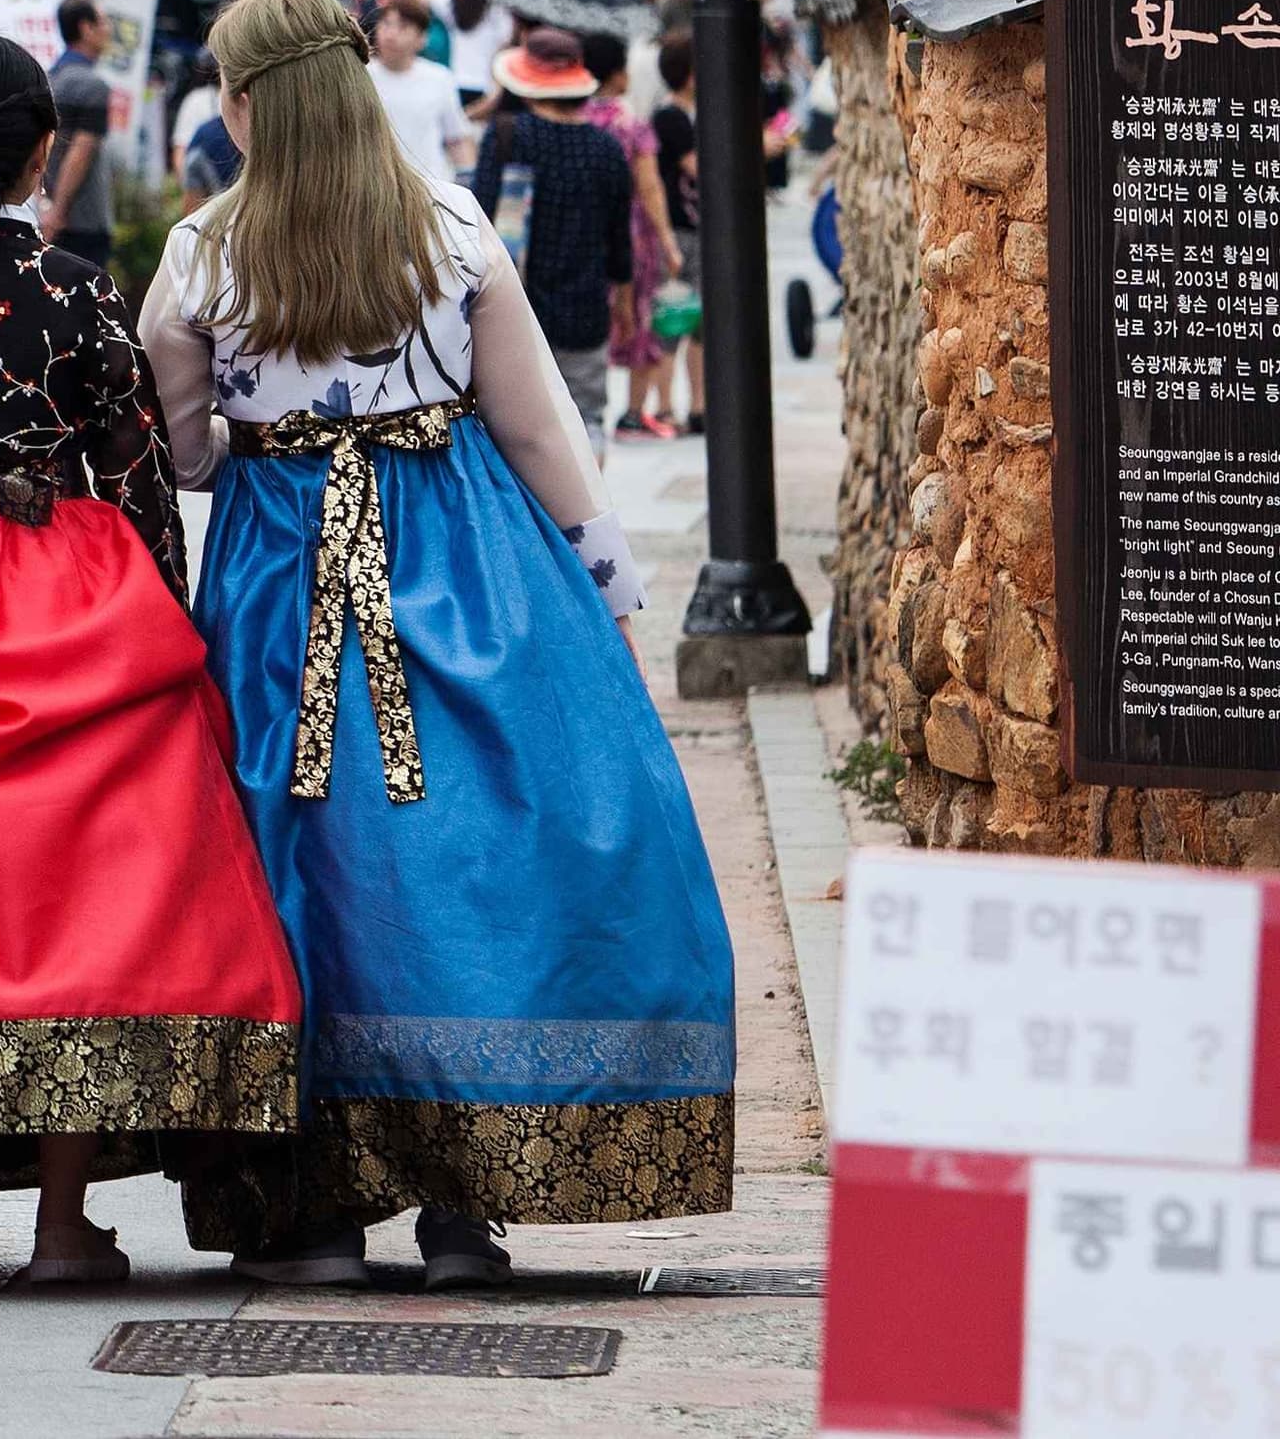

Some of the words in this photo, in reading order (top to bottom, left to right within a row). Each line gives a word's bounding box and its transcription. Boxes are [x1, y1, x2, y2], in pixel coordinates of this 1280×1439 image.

[1229, 97, 1245, 117] 는
[1110, 119, 1157, 140] 황제와
[1164, 121, 1240, 142] 명성황후의
[1249, 123, 1280, 143] 직계
[1231, 159, 1246, 178] 는
[1112, 181, 1190, 202] 이어간다는
[1198, 183, 1229, 203] 이을
[1113, 206, 1174, 227] 의미에서
[1183, 208, 1229, 228] 지어진
[1128, 243, 1175, 263] 전주는
[1183, 244, 1214, 264] 조선
[1222, 244, 1270, 266] 황실의
[1113, 268, 1166, 289] 으로써,
[1174, 270, 1229, 290] 2003년
[1237, 270, 1279, 291] 8월에
[1114, 292, 1129, 312] 에
[1138, 293, 1169, 314] 따라
[1176, 293, 1208, 314] 황손
[1217, 295, 1280, 316] 이석님을
[1114, 317, 1146, 337] 남로
[1153, 319, 1179, 339] 3가
[1186, 321, 1263, 341] 42-10번지
[1235, 357, 1252, 377] 는
[1116, 379, 1147, 399] 대한
[1155, 380, 1201, 401] 강연을
[1209, 381, 1257, 402] 하시는
[1118, 444, 1221, 464] Seounggwangjae
[1224, 448, 1234, 462] is
[1237, 451, 1245, 462] a
[1118, 467, 1141, 480] and
[1144, 470, 1160, 481] an
[1163, 468, 1211, 485] Imperial
[1214, 469, 1280, 485] Grandchild
[1119, 490, 1144, 502] new
[1146, 491, 1180, 503] name
[1181, 490, 1194, 504] of
[1196, 490, 1217, 504] this
[1219, 493, 1264, 509] country
[1119, 515, 1143, 530] The
[1146, 519, 1180, 531] name
[1119, 537, 1160, 555] "bright
[1163, 539, 1195, 556] light"
[1198, 541, 1222, 554] and
[1226, 541, 1275, 559] Seoung
[1119, 565, 1161, 583] Jeonju
[1164, 569, 1176, 580] is
[1178, 570, 1187, 581] a
[1190, 568, 1218, 581] birth
[1221, 569, 1255, 585] place
[1258, 570, 1271, 584] of
[1120, 586, 1147, 602] Lee,
[1149, 587, 1196, 602] founder
[1198, 589, 1211, 603] of
[1213, 592, 1221, 603] a
[1224, 590, 1271, 605] Chosun
[1121, 608, 1195, 625] Respectable
[1197, 611, 1217, 624] will
[1219, 611, 1232, 625] of
[1233, 612, 1273, 630] Wanju
[1121, 630, 1138, 644] An
[1141, 630, 1188, 648] imperial
[1190, 632, 1218, 646] child
[1221, 633, 1245, 647] Suk
[1122, 651, 1152, 666] 3-Ga
[1162, 653, 1245, 671] Pungnam-Ro,
[1122, 679, 1224, 699] Seounggwangjae
[1226, 684, 1236, 697] is
[1238, 686, 1247, 697] a
[1122, 700, 1167, 719] family's
[1169, 703, 1221, 719] tradition,
[1224, 705, 1265, 720] culture
